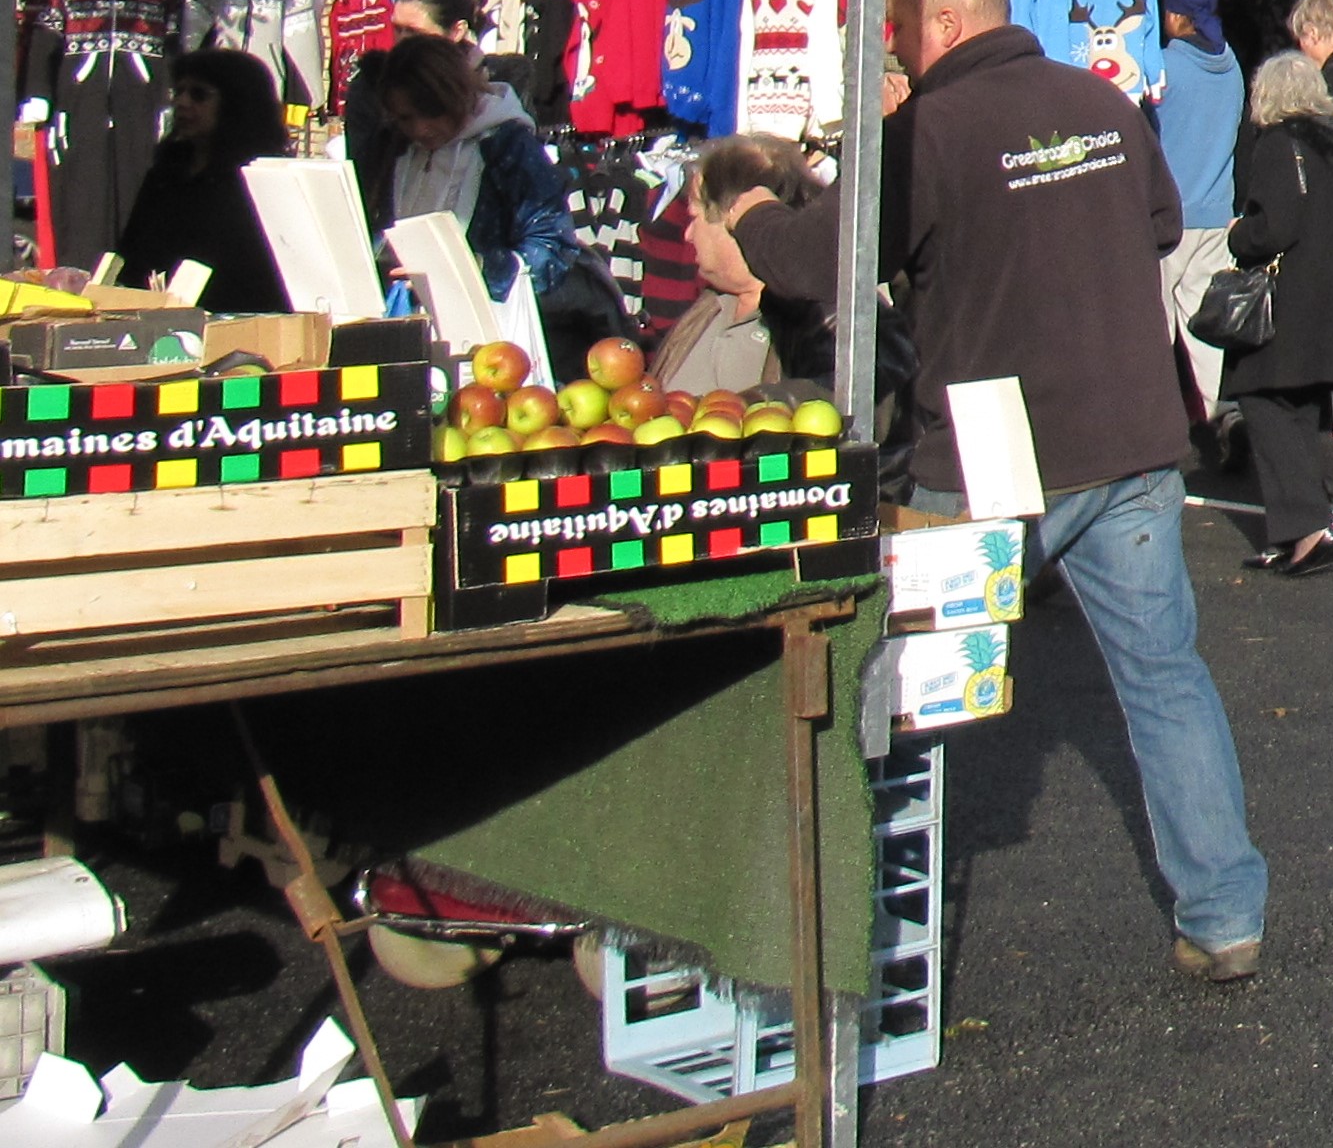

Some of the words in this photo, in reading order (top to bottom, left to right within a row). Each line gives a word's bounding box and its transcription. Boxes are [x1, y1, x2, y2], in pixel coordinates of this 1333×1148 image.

[1002, 138, 1081, 169] Greengrocer's
[1080, 130, 1122, 151] Choice
[168, 408, 398, 450] d'Aquitaine
[691, 483, 852, 519] Domaines
[489, 503, 685, 545] d'Aquitaine
